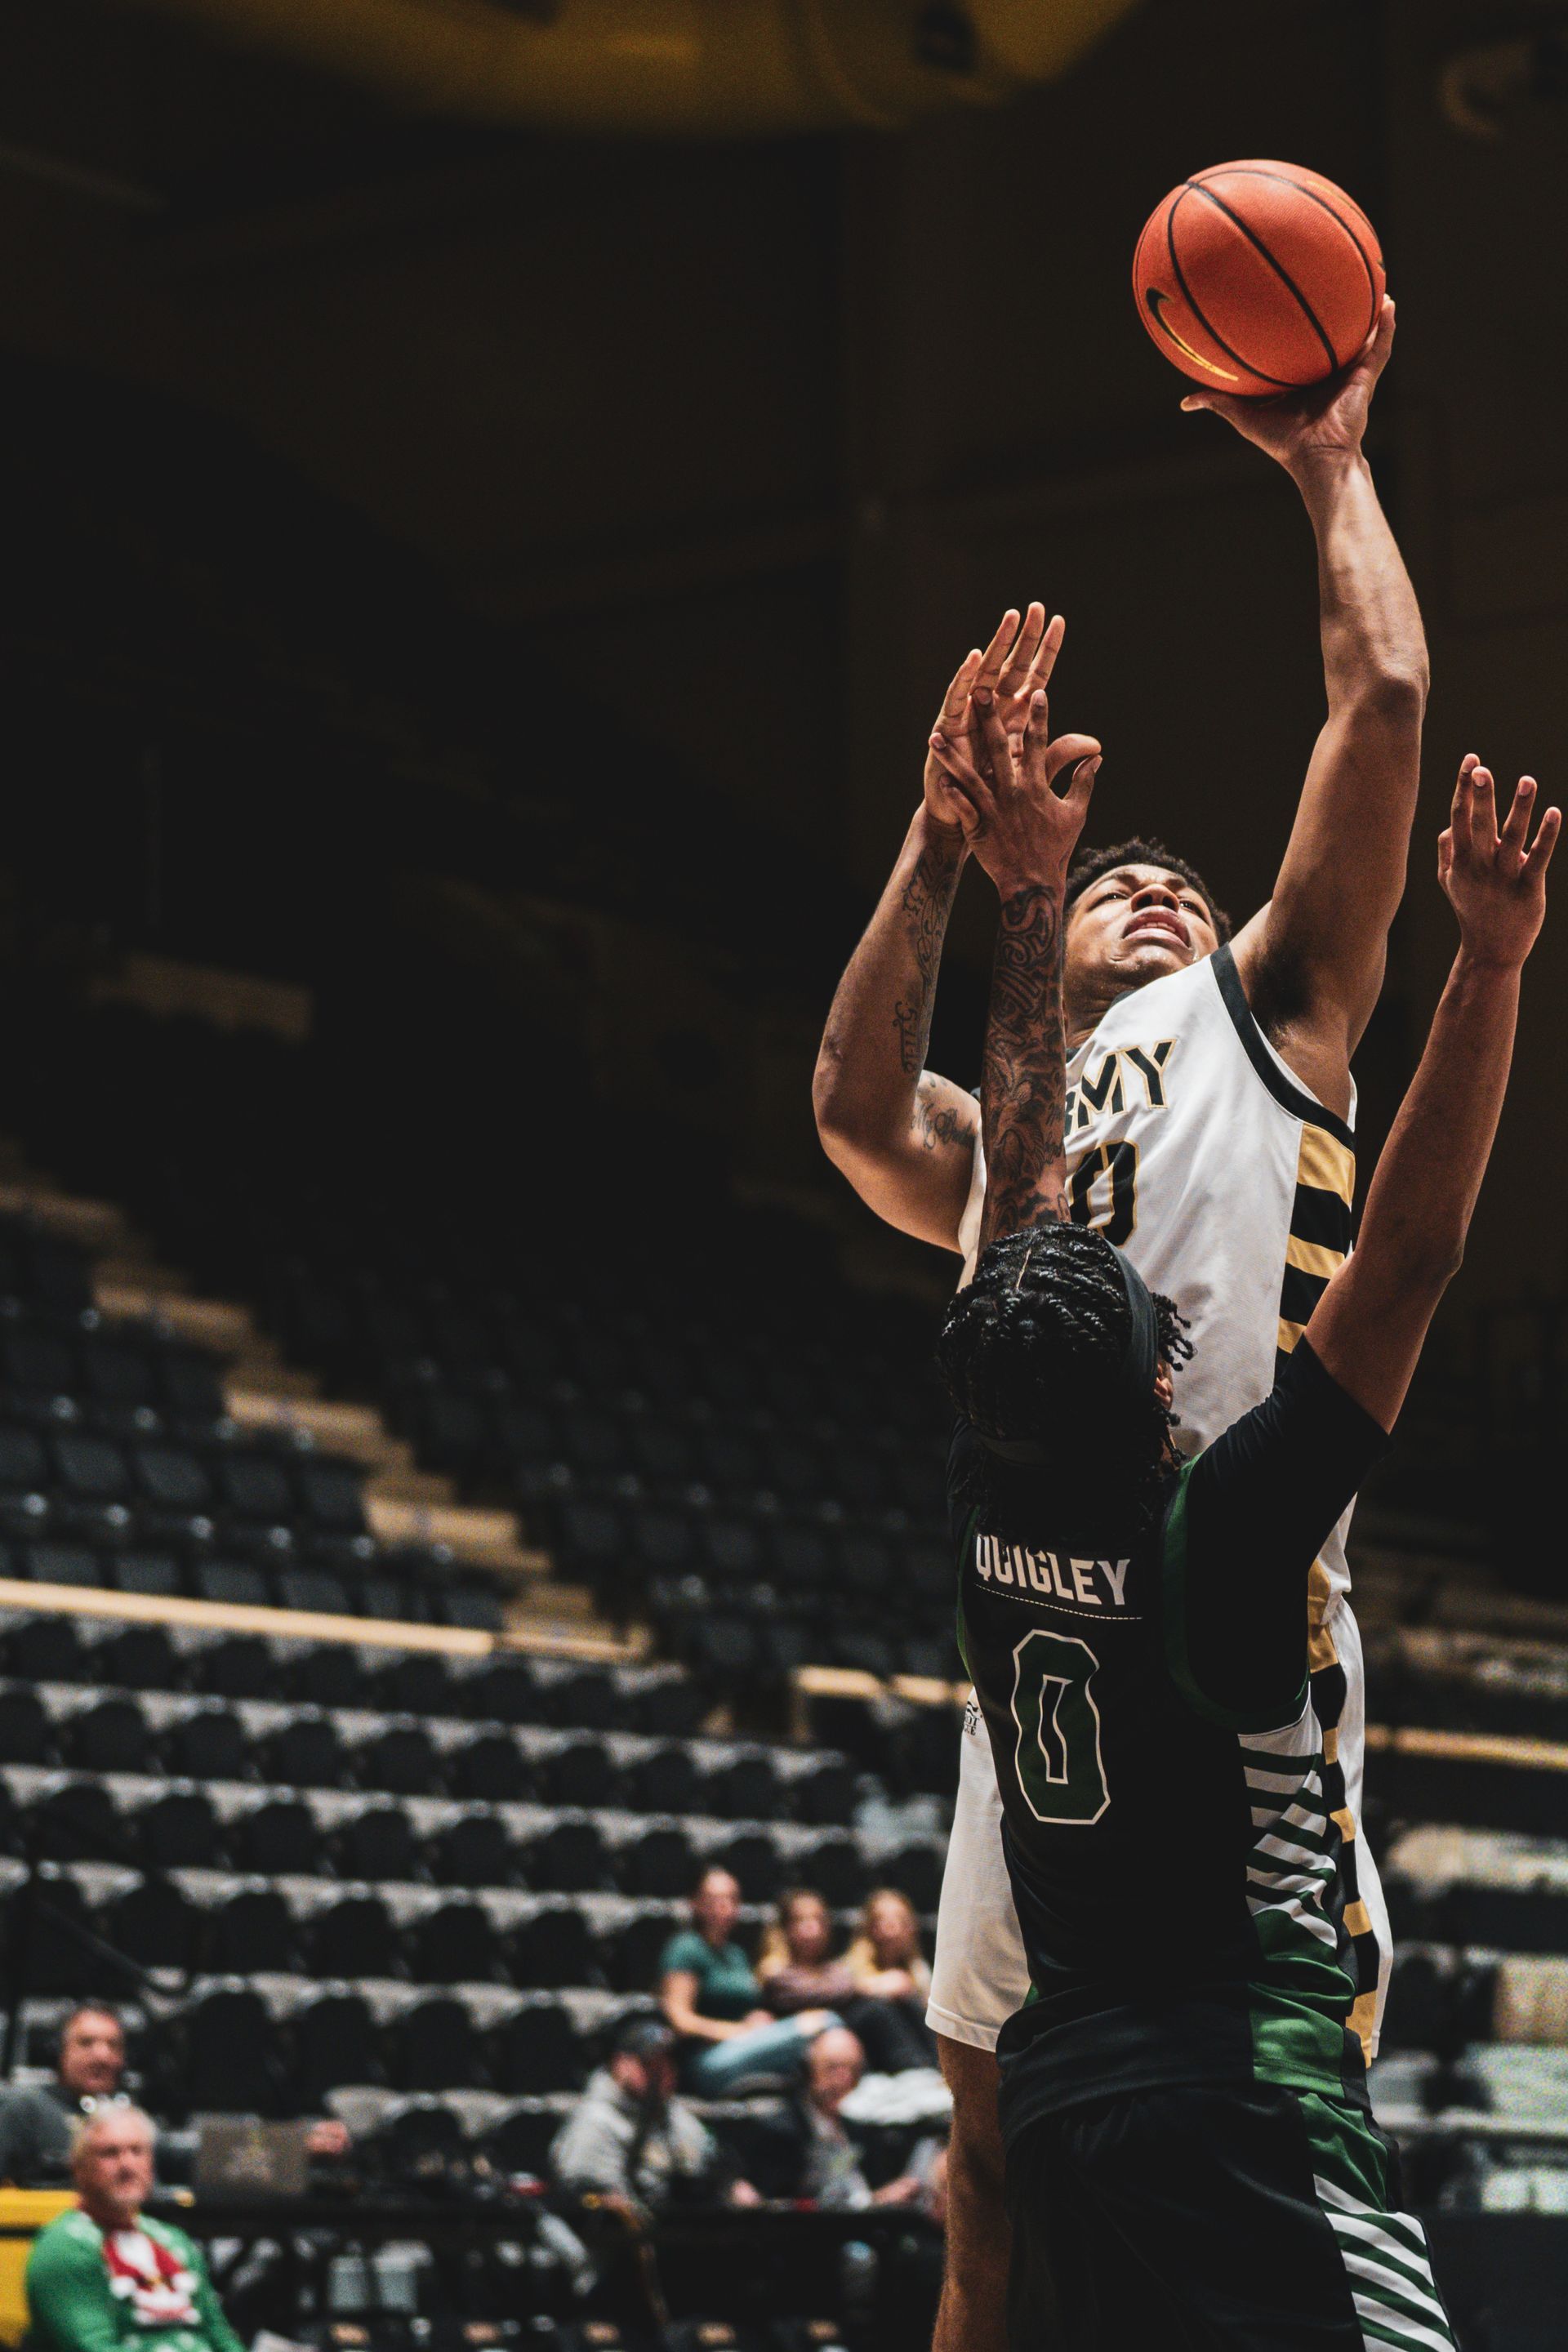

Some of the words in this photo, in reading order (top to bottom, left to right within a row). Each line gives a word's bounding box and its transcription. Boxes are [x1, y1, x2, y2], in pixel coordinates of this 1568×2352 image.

[1064, 1038, 1177, 1137] MY
[975, 1533, 1131, 1606] QUIGLEY
[1010, 1628, 1111, 1825] 0
